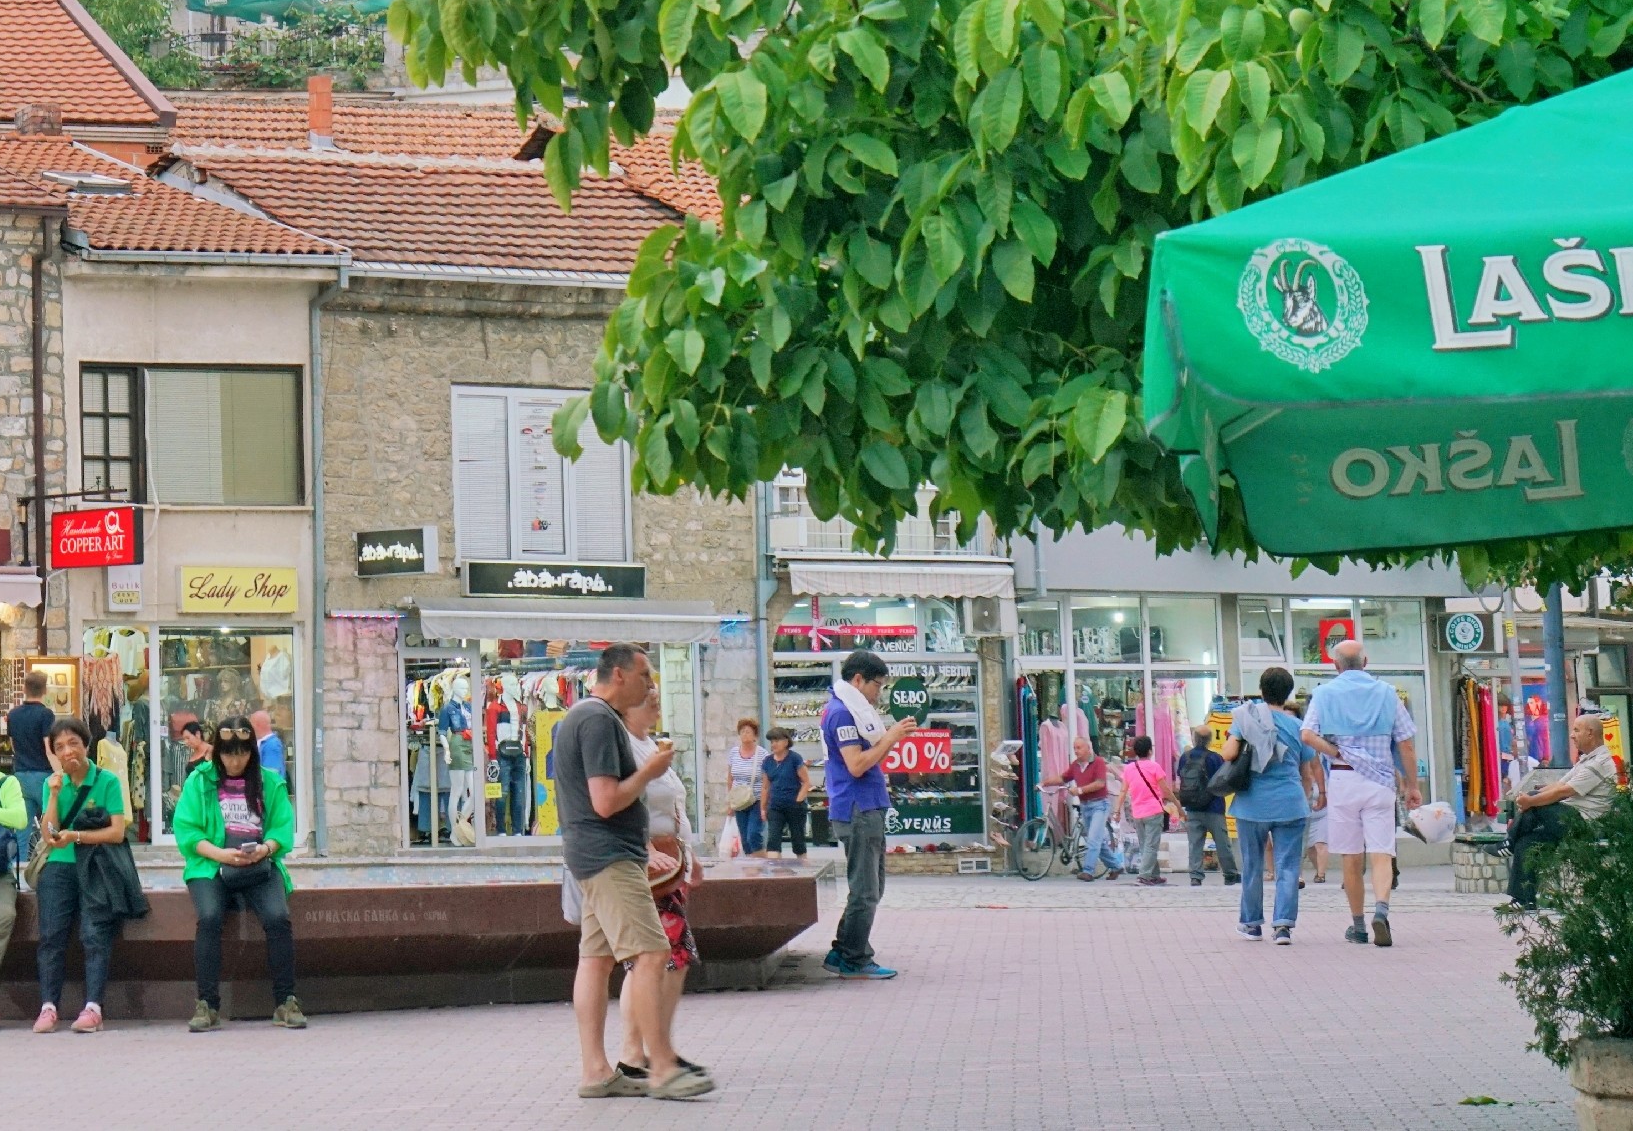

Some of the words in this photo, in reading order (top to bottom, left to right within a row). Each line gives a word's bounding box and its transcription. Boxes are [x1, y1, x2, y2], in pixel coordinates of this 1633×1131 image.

[1414, 236, 1633, 351] LAŠ
[60, 536, 103, 554] COPPER
[103, 535, 125, 551] ART
[189, 572, 241, 607] Lady
[244, 572, 292, 608] Shop
[885, 663, 917, 677] НИЦА
[921, 664, 936, 677] ЗА
[938, 665, 972, 677] ЧЕВЛИ
[893, 690, 926, 705] SEBO
[839, 725, 857, 738] 012
[886, 741, 918, 769] 50
[923, 741, 950, 769] %
